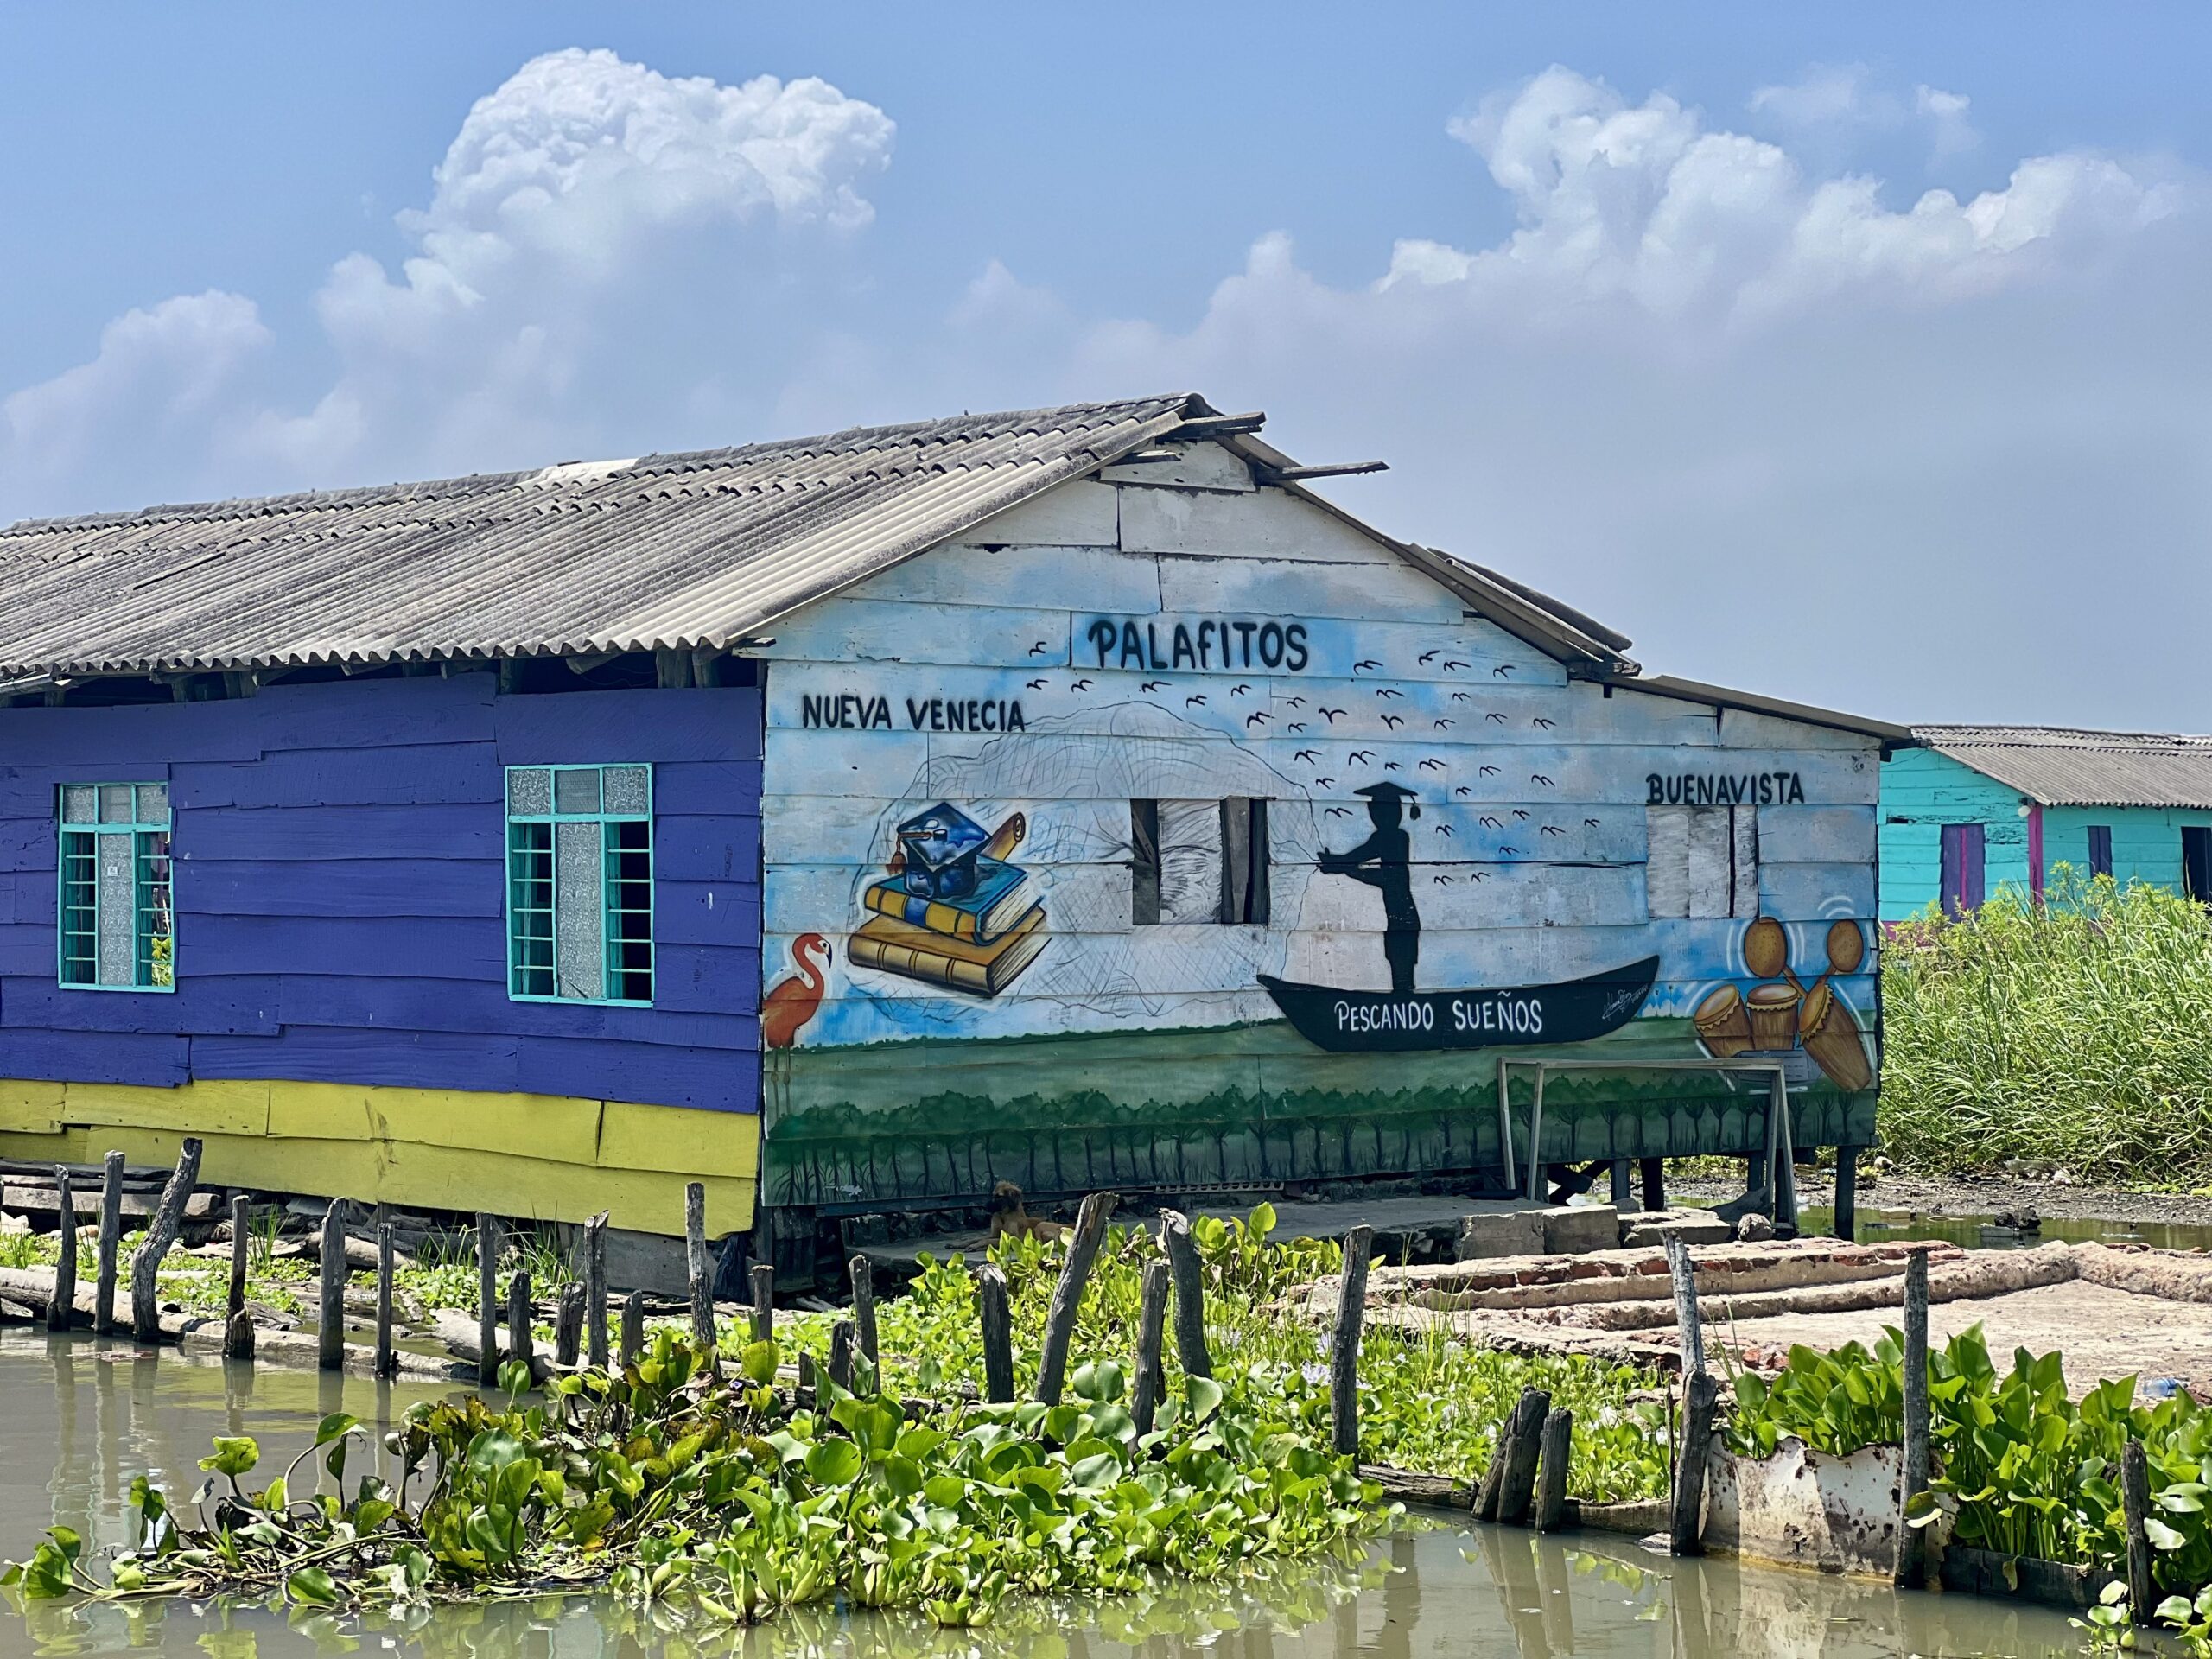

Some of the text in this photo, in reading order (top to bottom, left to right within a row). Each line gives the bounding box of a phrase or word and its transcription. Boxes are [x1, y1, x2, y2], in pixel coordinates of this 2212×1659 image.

[1088, 620, 1309, 671] PALAFITOS
[802, 695, 1028, 733] NUEVA VENECIA
[1645, 772, 1805, 804] BUENAVISTA
[1334, 990, 1542, 1034] PESCANDO SUEÑOS
